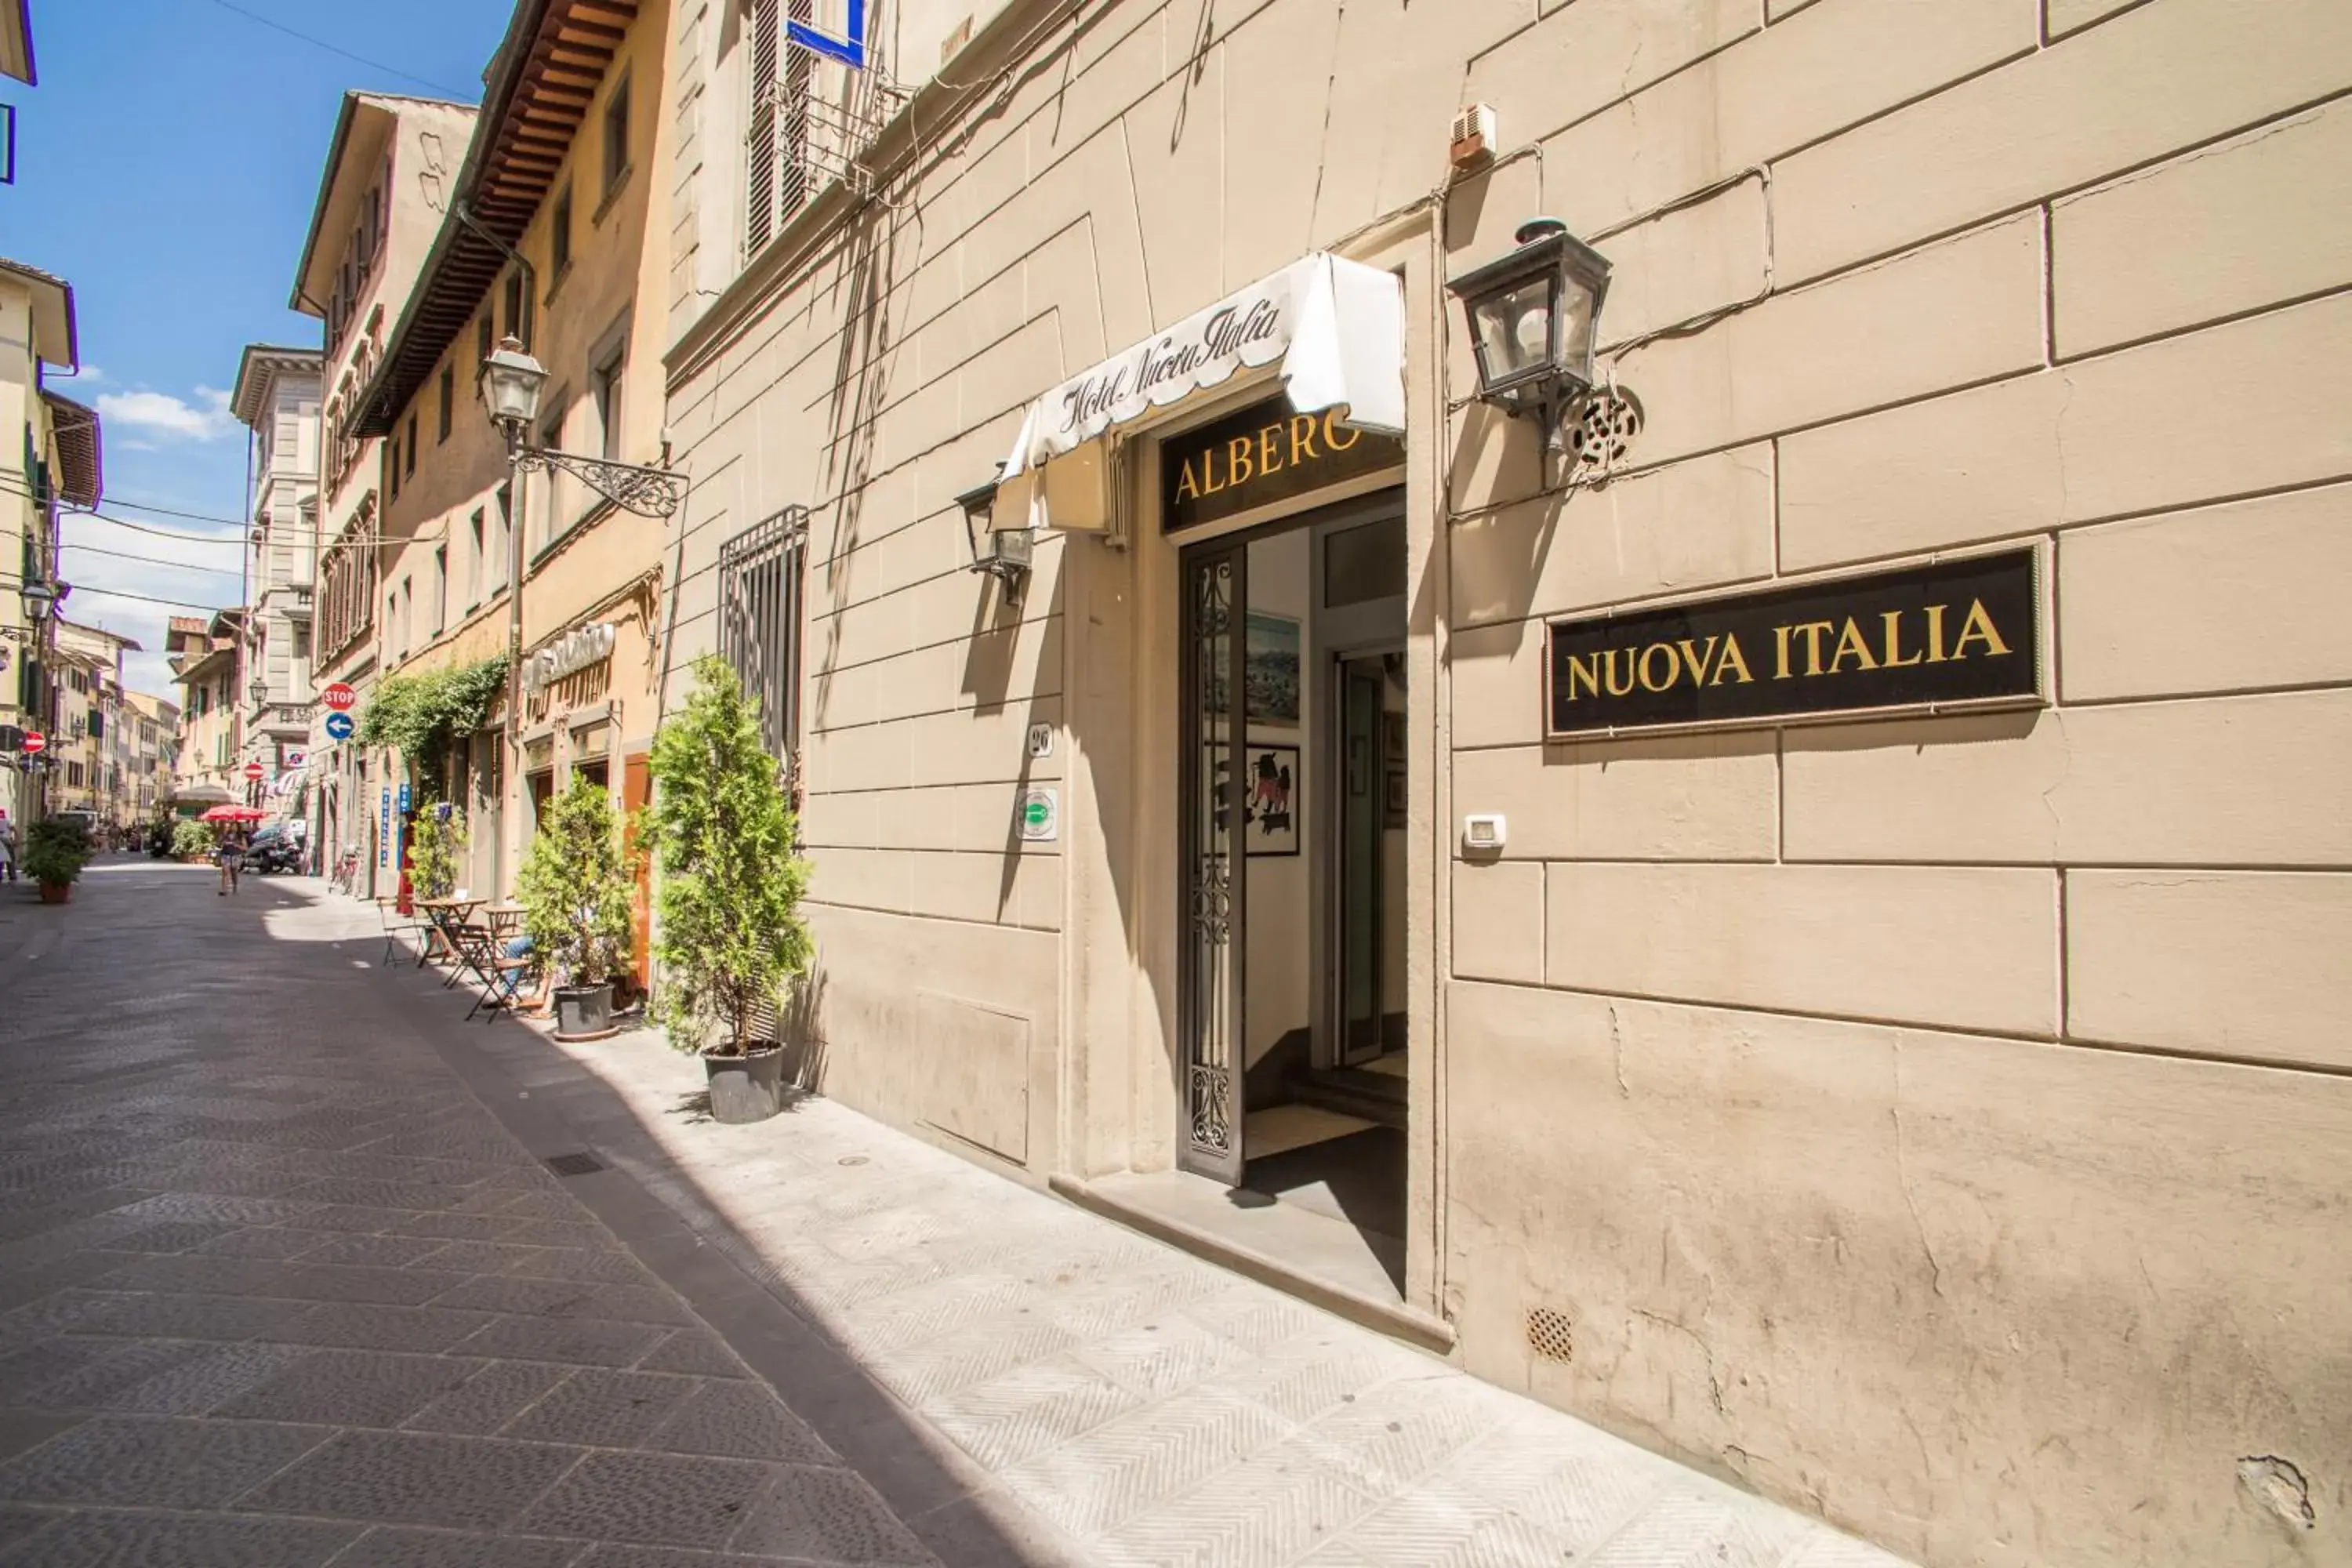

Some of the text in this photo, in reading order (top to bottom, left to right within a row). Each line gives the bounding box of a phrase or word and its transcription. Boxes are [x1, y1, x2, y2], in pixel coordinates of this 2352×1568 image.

[1060, 299, 1280, 433] Hotel Nuova Italia
[1174, 408, 1363, 504] ALBERG
[325, 690, 354, 703] STOP
[1566, 597, 2013, 701] NUOVA ITALIA
